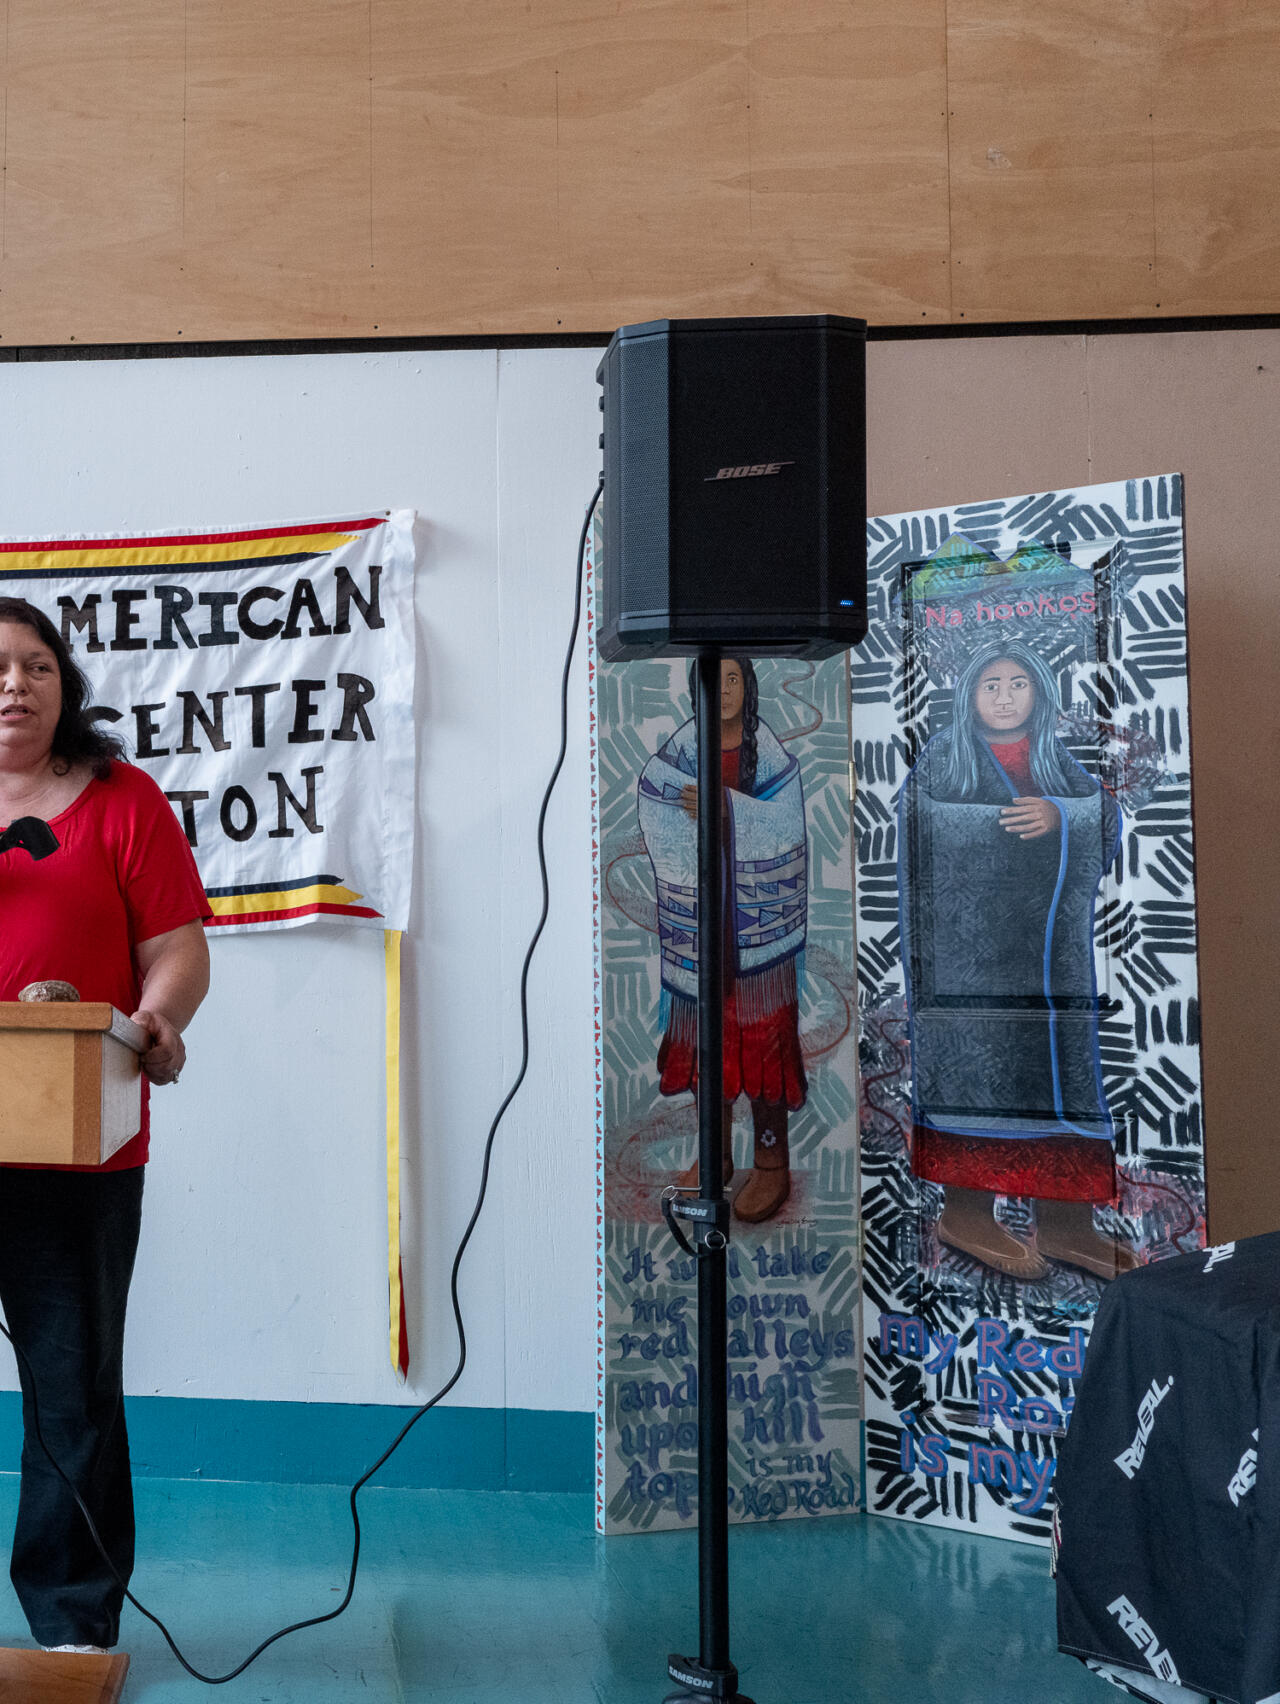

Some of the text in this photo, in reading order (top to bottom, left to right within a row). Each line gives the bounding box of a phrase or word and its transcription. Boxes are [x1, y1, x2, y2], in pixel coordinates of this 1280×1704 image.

[704, 461, 795, 481] BOSE
[57, 566, 384, 653] MERICAN
[926, 606, 963, 628] Na
[164, 765, 324, 847] TON
[622, 1245, 832, 1283] It wl take
[631, 1293, 811, 1322] me own
[617, 1319, 855, 1372] red alleys
[879, 1313, 1086, 1378] my Red
[620, 1364, 697, 1412] and
[621, 1401, 825, 1472] upo hill
[746, 1448, 834, 1487] is my
[900, 1410, 1057, 1515] is my
[627, 1461, 734, 1520] top
[740, 1480, 788, 1520] Red
[1106, 1594, 1181, 1686] REVE
[669, 1666, 714, 1689] SAMSON
